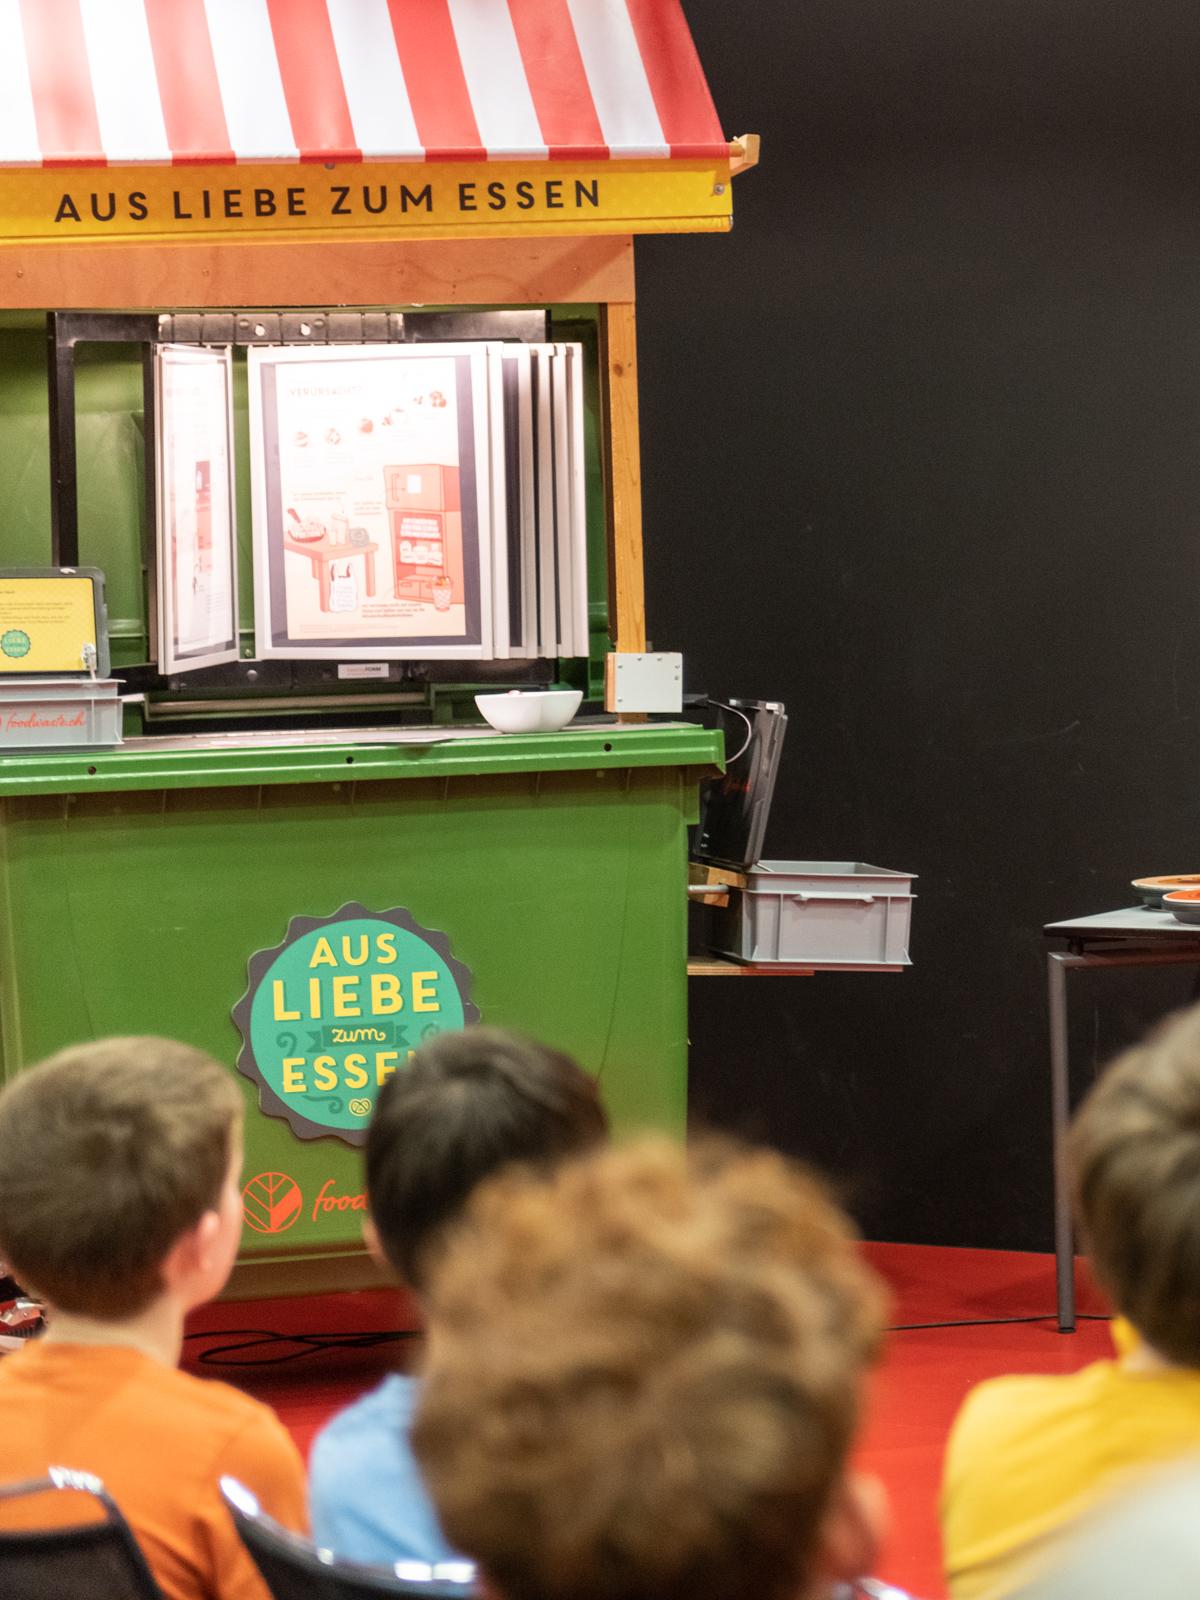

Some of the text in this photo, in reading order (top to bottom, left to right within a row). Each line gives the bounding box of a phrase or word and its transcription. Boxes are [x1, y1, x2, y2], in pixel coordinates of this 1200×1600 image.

[55, 180, 602, 223] AUS LIEBE ZUM ESSEN
[309, 933, 398, 968] AUS
[273, 971, 441, 1021] LIEBE
[332, 1027, 386, 1043] zum
[283, 1050, 416, 1093] ESSE
